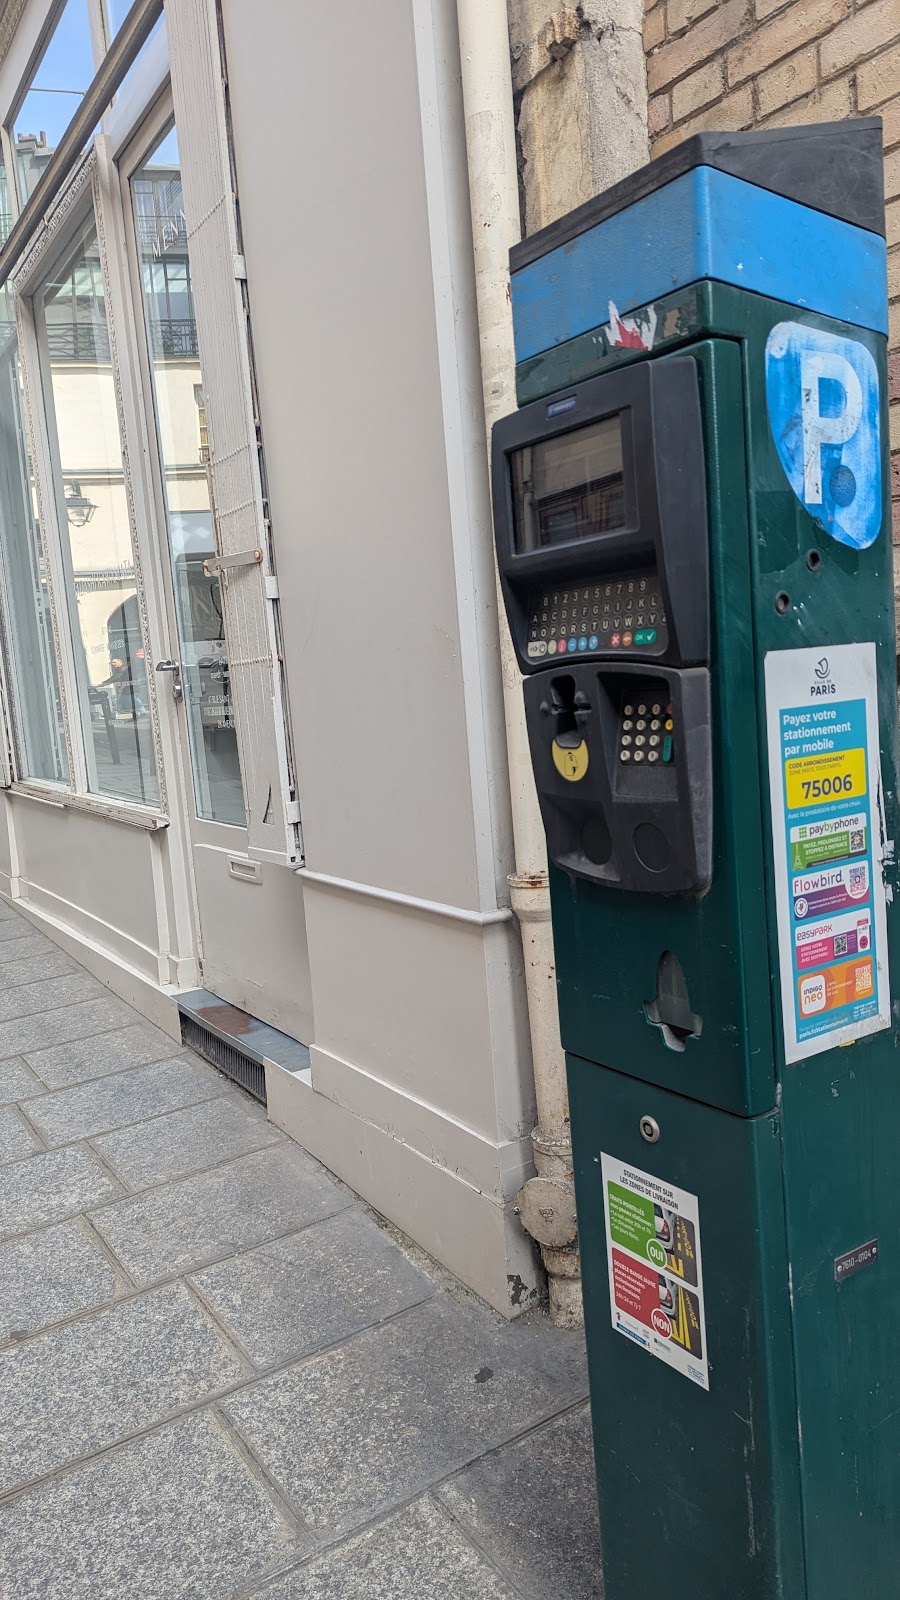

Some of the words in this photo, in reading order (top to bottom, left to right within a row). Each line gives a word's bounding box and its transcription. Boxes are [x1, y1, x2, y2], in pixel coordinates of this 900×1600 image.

[800, 348, 863, 505] P
[544, 597, 548, 607] 0
[554, 596, 557, 604] 1
[563, 595, 568, 604] 2
[573, 592, 578, 602] 3
[583, 591, 589, 600] 4
[594, 588, 600, 598] 5
[605, 586, 611, 596] 6
[617, 585, 622, 595] 7
[628, 582, 634, 592] 8
[640, 580, 646, 591] 9
[542, 612, 548, 621] B
[552, 611, 557, 620] C
[561, 610, 567, 618] D
[572, 608, 577, 617] E
[582, 607, 588, 616] F
[593, 605, 599, 614] G
[604, 603, 610, 613] H
[617, 602, 619, 611] I
[627, 600, 632, 609] J
[639, 598, 645, 608] K
[651, 597, 656, 606] L
[532, 630, 537, 638] N
[541, 628, 546, 637] O
[560, 626, 566, 635] Q
[571, 624, 576, 633] R
[581, 623, 587, 632] S
[592, 621, 597, 631] T
[602, 620, 608, 629] U
[614, 618, 620, 627] V
[625, 617, 633, 626] W
[637, 616, 644, 625] X
[650, 615, 655, 623] Y
[810, 683, 835, 696] PARIS
[783, 711, 811, 728] Payez
[812, 708, 836, 721] votre
[783, 720, 851, 740] stationnement
[784, 745, 800, 757] par
[802, 737, 834, 752] mobile
[789, 761, 801, 769] CODE
[803, 754, 844, 766] ARRONDISSEMENT
[801, 773, 852, 799] 75006
[787, 811, 799, 819] Avec
[805, 806, 829, 817] prestataire
[849, 799, 860, 807] choix
[809, 815, 858, 837] paybyphone
[805, 846, 823, 855] STOPPEZ
[828, 840, 847, 850] DISTANCE
[817, 835, 841, 846] PROLONGEZ
[794, 869, 841, 893] flowbird
[804, 991, 822, 1004] neo
[619, 1175, 627, 1185] LES
[628, 1180, 644, 1193] ZONES
[645, 1188, 651, 1197] DE
[652, 1191, 678, 1210] LIVRAISON
[623, 1168, 661, 1193] STATIONNEMENT
[662, 1187, 673, 1198] SUR
[649, 1245, 663, 1262] OUI
[613, 1259, 629, 1273] DOUBLE
[629, 1268, 642, 1281] BANDE
[643, 1276, 656, 1289] JAUNE
[653, 1313, 669, 1334] NON
